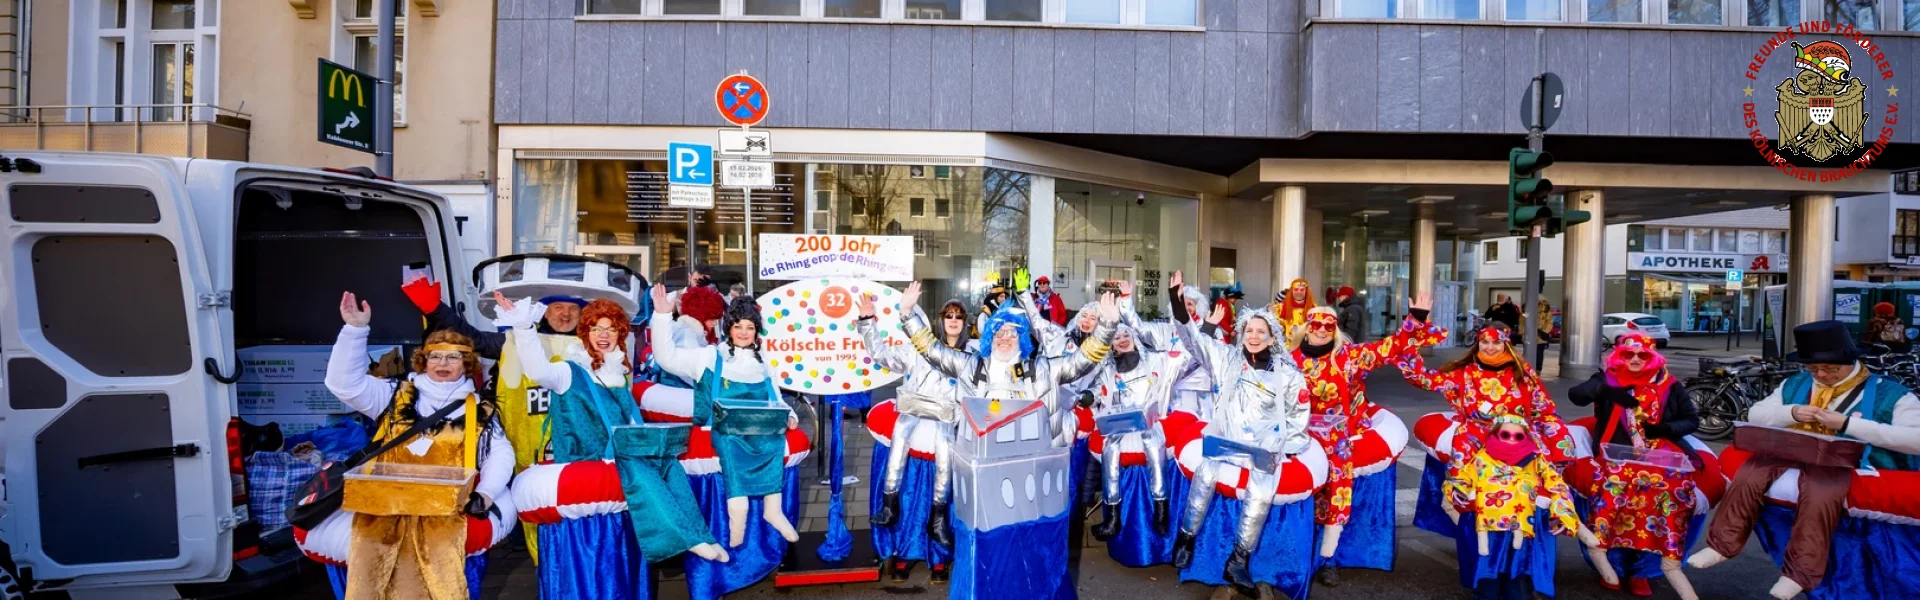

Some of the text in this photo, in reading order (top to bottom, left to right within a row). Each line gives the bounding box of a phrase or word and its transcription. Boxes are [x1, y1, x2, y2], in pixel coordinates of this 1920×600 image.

[676, 148, 699, 178] P
[795, 236, 881, 255] 200 Johr
[761, 266, 775, 277] de
[776, 257, 811, 273] Rhing
[812, 253, 837, 265] erop
[839, 252, 855, 262] de
[856, 256, 887, 274] Rhing
[1642, 256, 1735, 269] APOTHEKE
[1144, 270, 1156, 278] THIS
[1144, 279, 1159, 288] YOUR
[1144, 288, 1158, 296] SIGN
[826, 293, 845, 306] 32
[766, 337, 836, 352] Kölsche
[527, 388, 551, 413] PE
